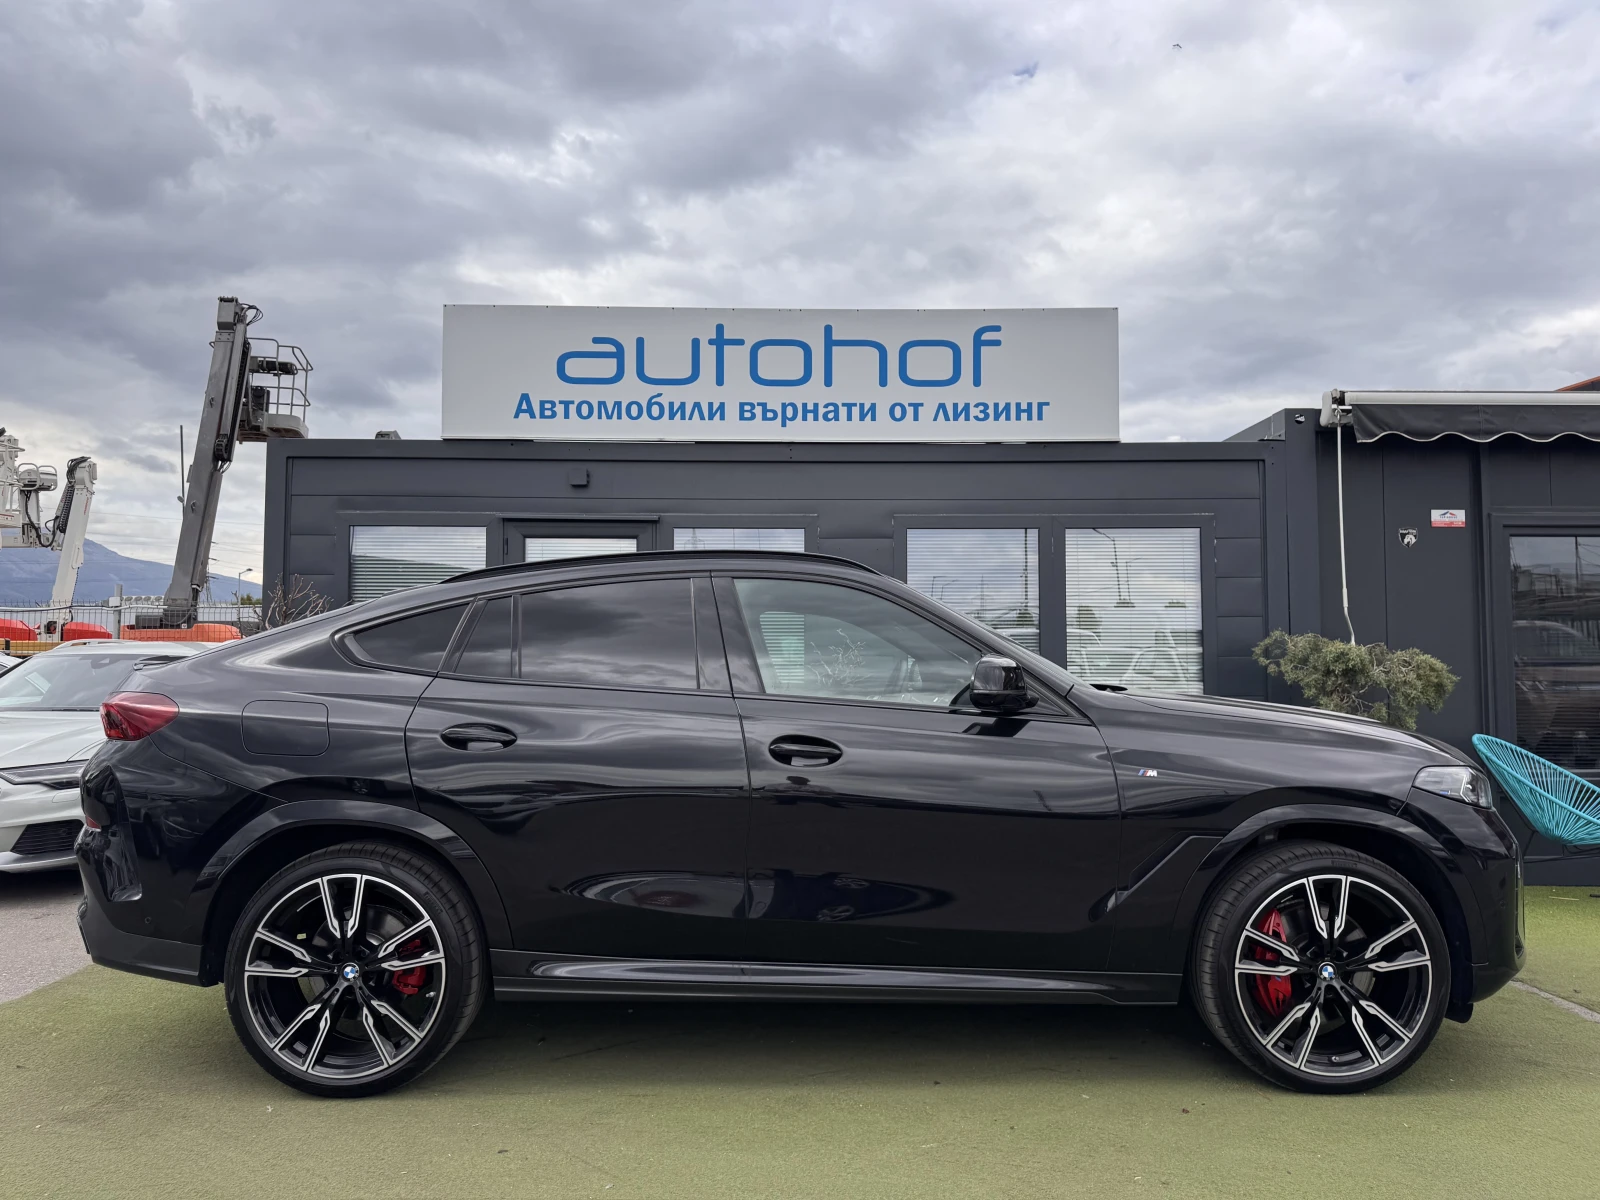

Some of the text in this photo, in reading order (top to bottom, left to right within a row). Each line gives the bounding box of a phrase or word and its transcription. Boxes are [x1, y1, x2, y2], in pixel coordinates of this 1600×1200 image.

[556, 323, 1003, 388] autohof
[513, 392, 1051, 429] Автомобили върнати от лизинг
